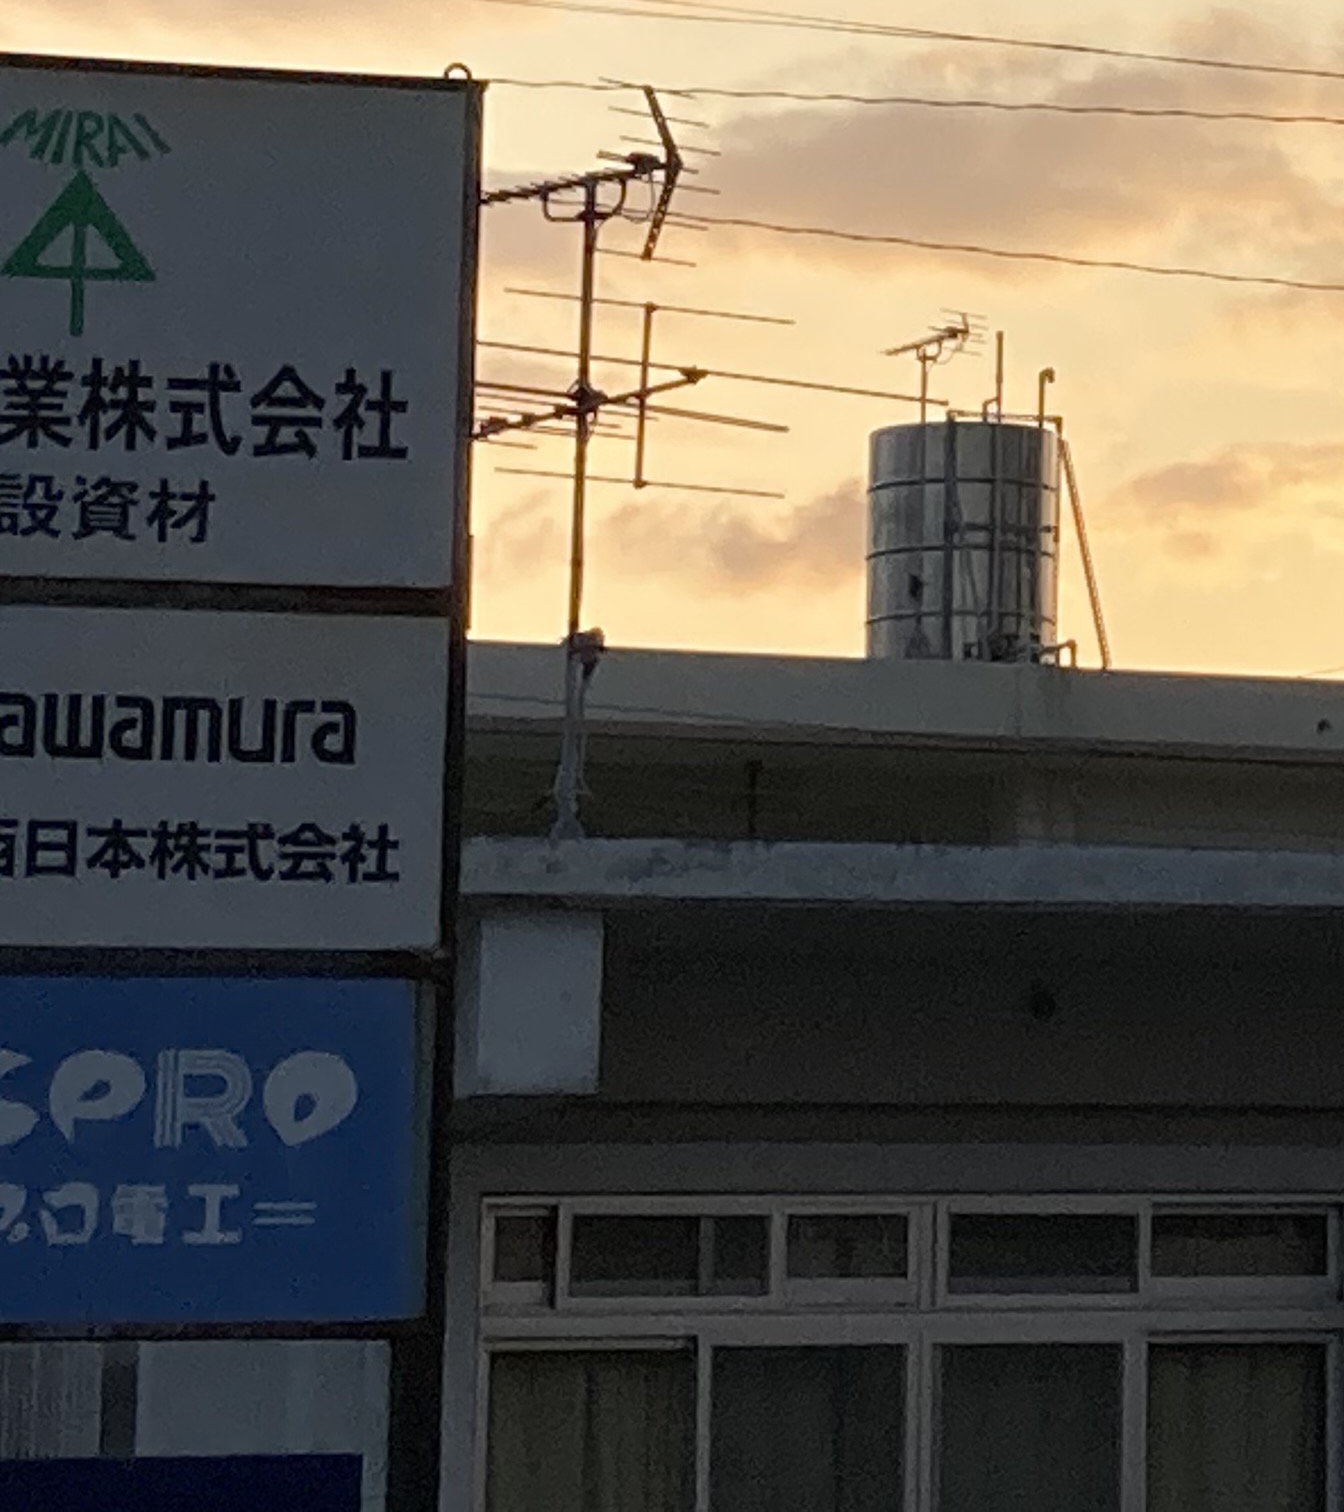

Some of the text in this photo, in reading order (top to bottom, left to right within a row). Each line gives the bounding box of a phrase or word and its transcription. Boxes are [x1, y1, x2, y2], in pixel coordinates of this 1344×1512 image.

[0, 107, 173, 169] MIRAI
[0, 353, 409, 462] 業株式会社
[0, 473, 216, 544] 設資材
[0, 692, 358, 765] awamura
